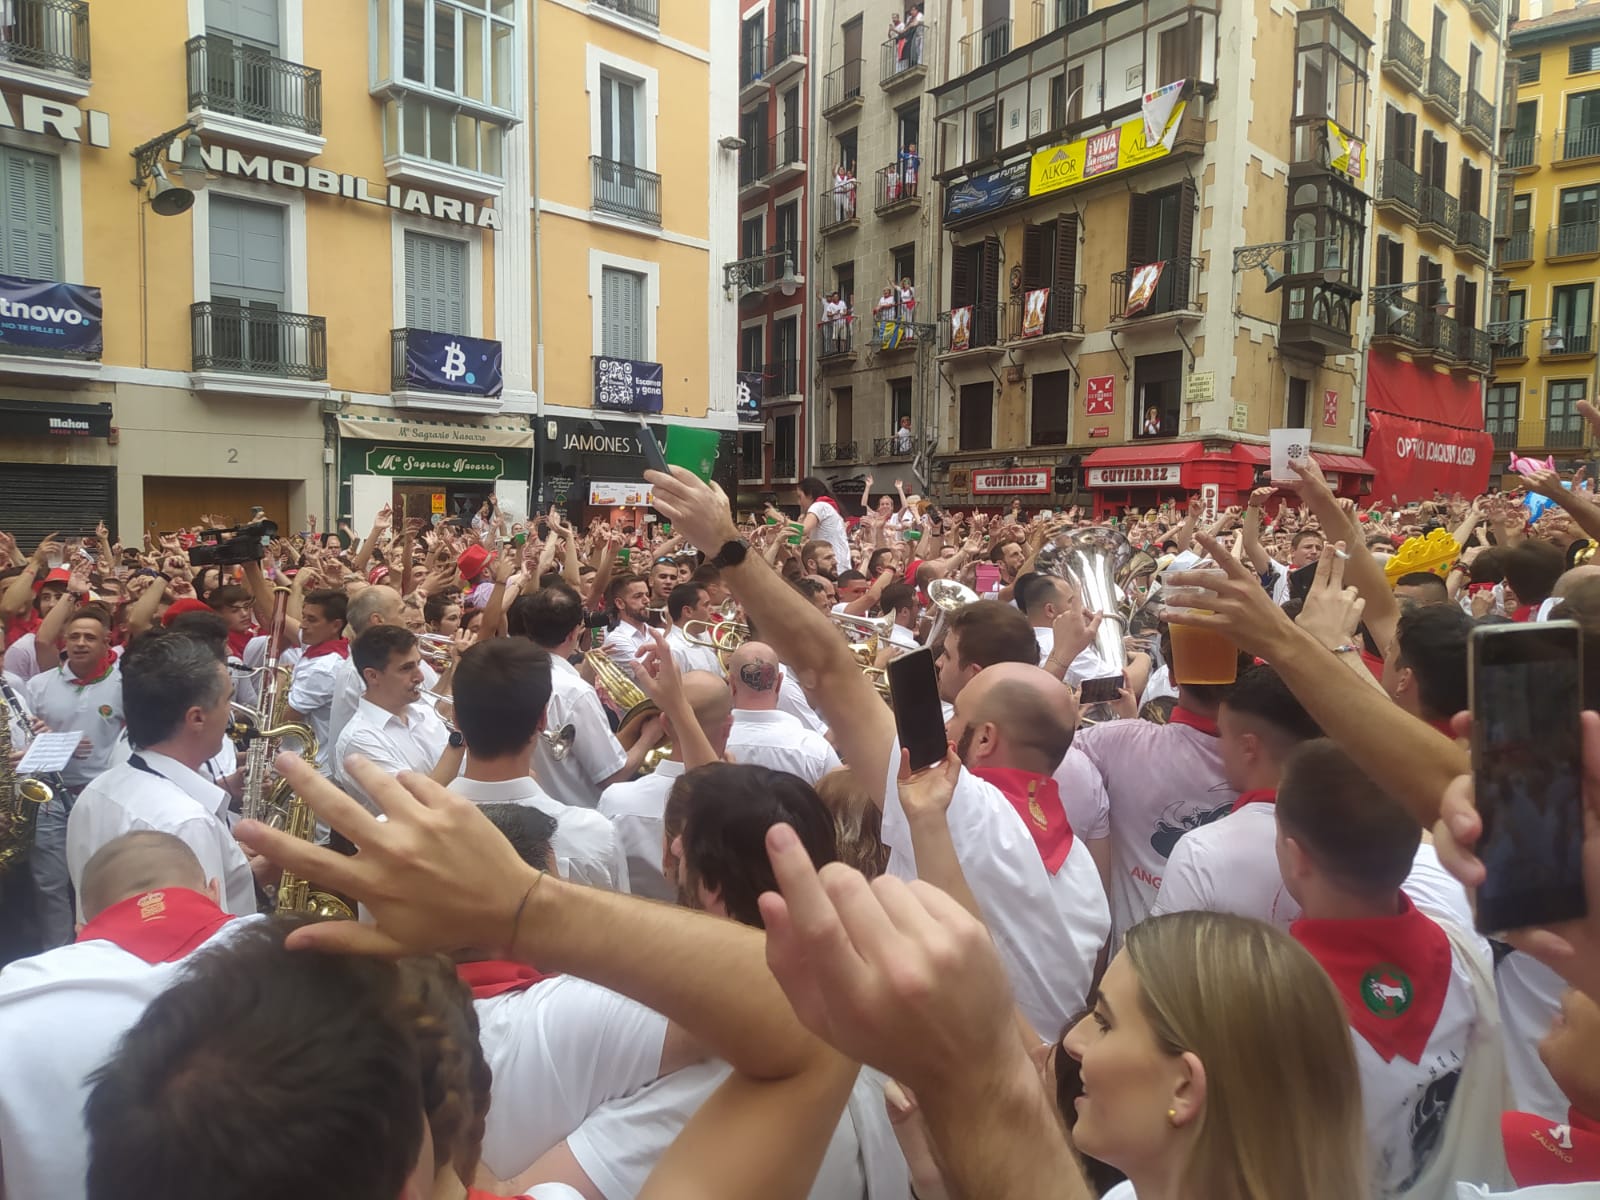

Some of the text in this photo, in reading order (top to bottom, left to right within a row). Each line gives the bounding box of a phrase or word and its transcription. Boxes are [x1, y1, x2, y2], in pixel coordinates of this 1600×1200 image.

[1040, 159, 1077, 182] ALKOR
[168, 138, 502, 231] INMOBILIARIA
[49, 417, 89, 429] Mahou
[411, 428, 450, 440] Sagrario
[452, 432, 486, 442] Navarro
[562, 433, 630, 453] JAMONES
[227, 447, 239, 463] 2
[403, 456, 450, 471] Sagrario
[452, 458, 496, 473] Navarro
[984, 474, 1038, 487] GUTIERREZ
[1100, 467, 1168, 482] GUTIERREZ
